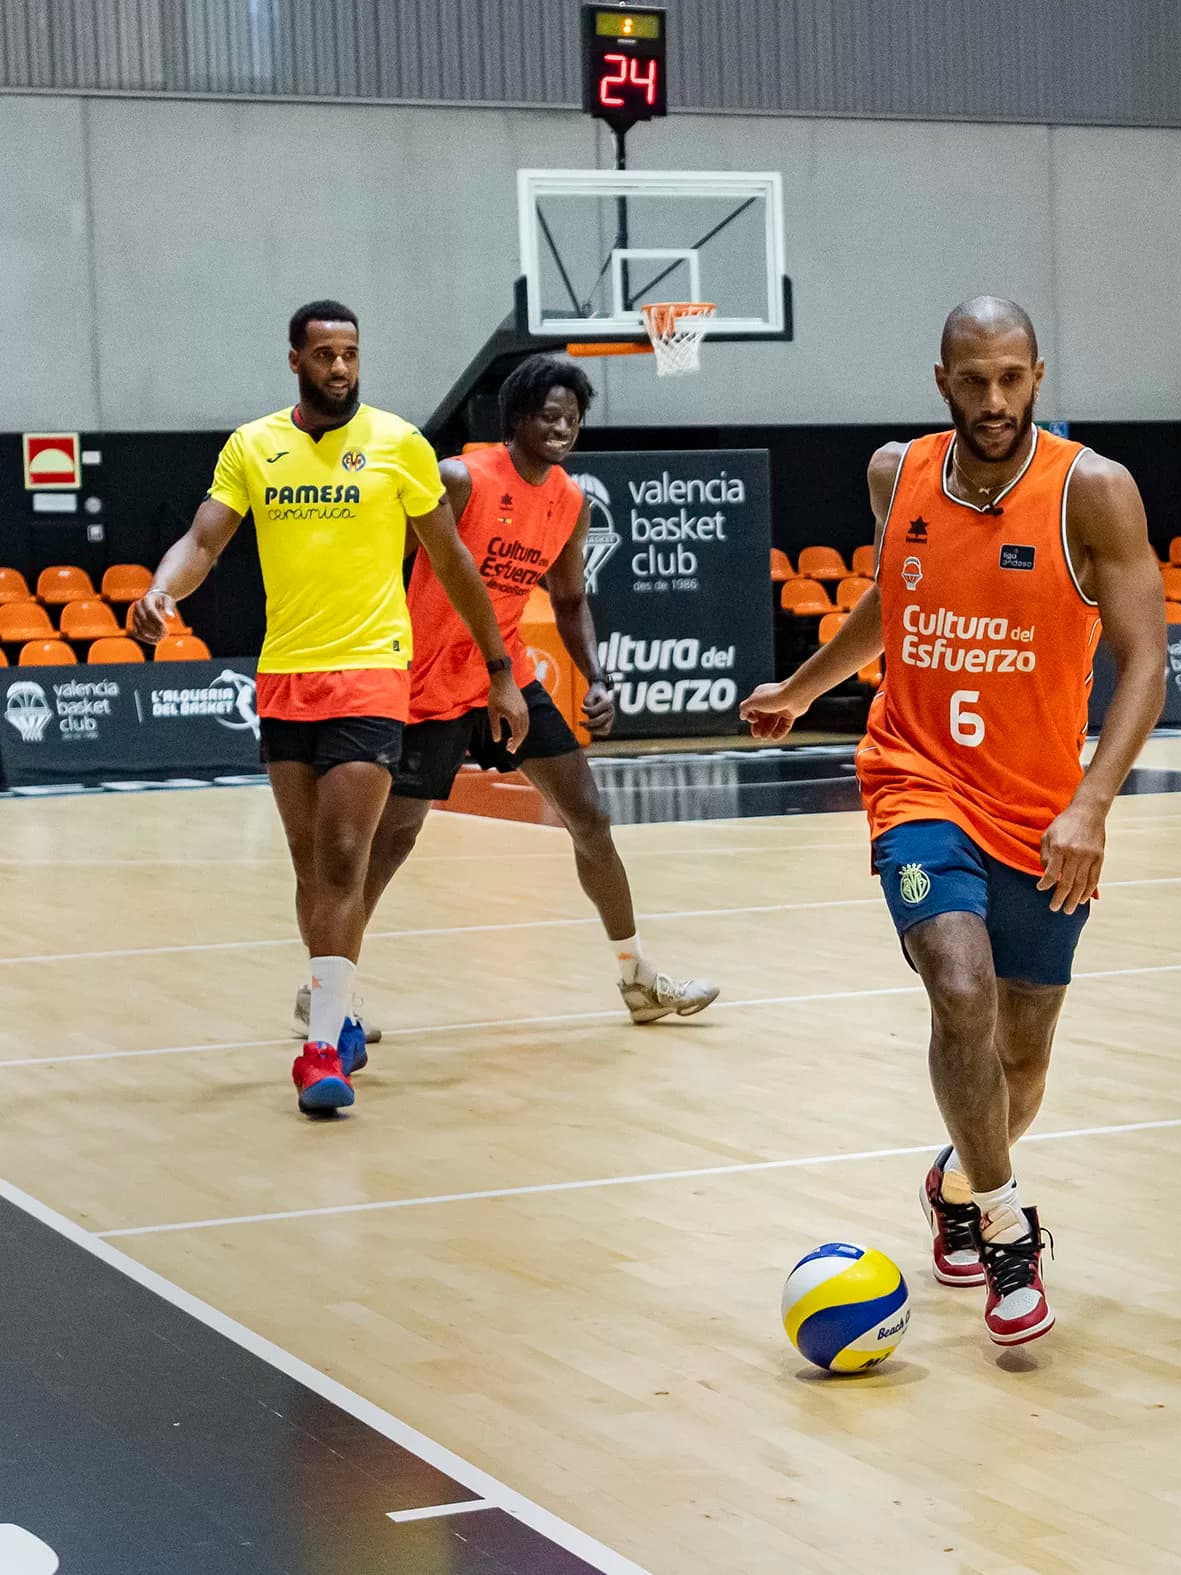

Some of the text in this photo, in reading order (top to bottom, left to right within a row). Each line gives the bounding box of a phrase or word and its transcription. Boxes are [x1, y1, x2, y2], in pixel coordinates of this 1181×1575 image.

[600, 54, 656, 106] 24
[265, 485, 360, 505] PAMESA
[628, 471, 745, 504] valencia
[631, 508, 728, 542] basket
[487, 536, 542, 564] Cultura
[631, 543, 698, 577] club
[633, 578, 698, 592] des de 1986
[903, 604, 1035, 642] Cultura del
[598, 632, 735, 672] ltura del
[902, 635, 1036, 673] Esfuerzo
[53, 679, 120, 697] valencia
[609, 672, 738, 714] fuerzo
[56, 697, 112, 715] basket
[153, 701, 234, 716] DEL BASKET
[950, 689, 985, 747] 6
[59, 715, 97, 732] club
